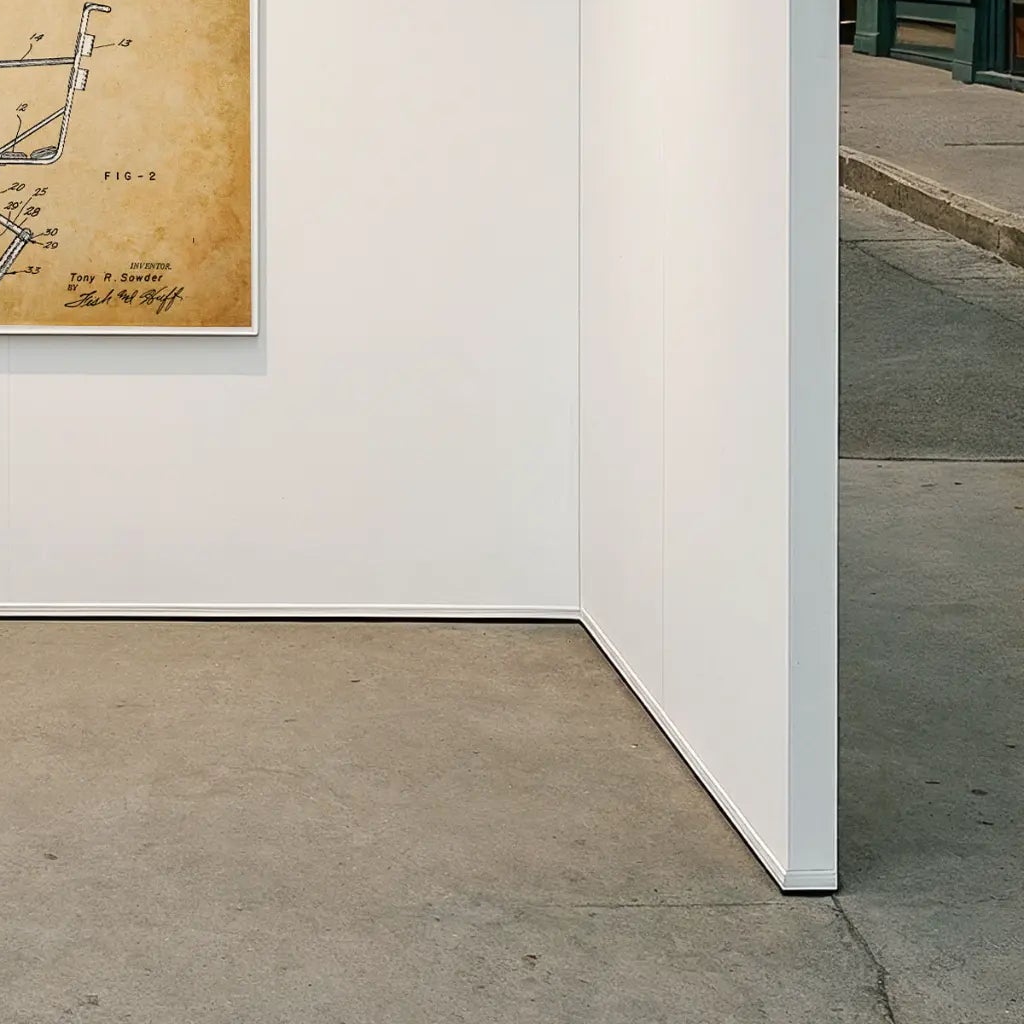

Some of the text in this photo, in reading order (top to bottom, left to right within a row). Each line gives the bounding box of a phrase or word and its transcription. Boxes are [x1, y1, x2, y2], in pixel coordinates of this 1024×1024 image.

[29, 33, 45, 42] 14
[117, 39, 133, 47] 13
[16, 103, 27, 112] 12
[7, 182, 26, 192] 20
[32, 187, 49, 197] 25
[24, 206, 41, 217] 28
[43, 228, 59, 236] 30
[43, 241, 59, 249] 29
[26, 266, 42, 274] 33
[70, 273, 95, 284] Tony
[120, 273, 163, 282] Sowder
